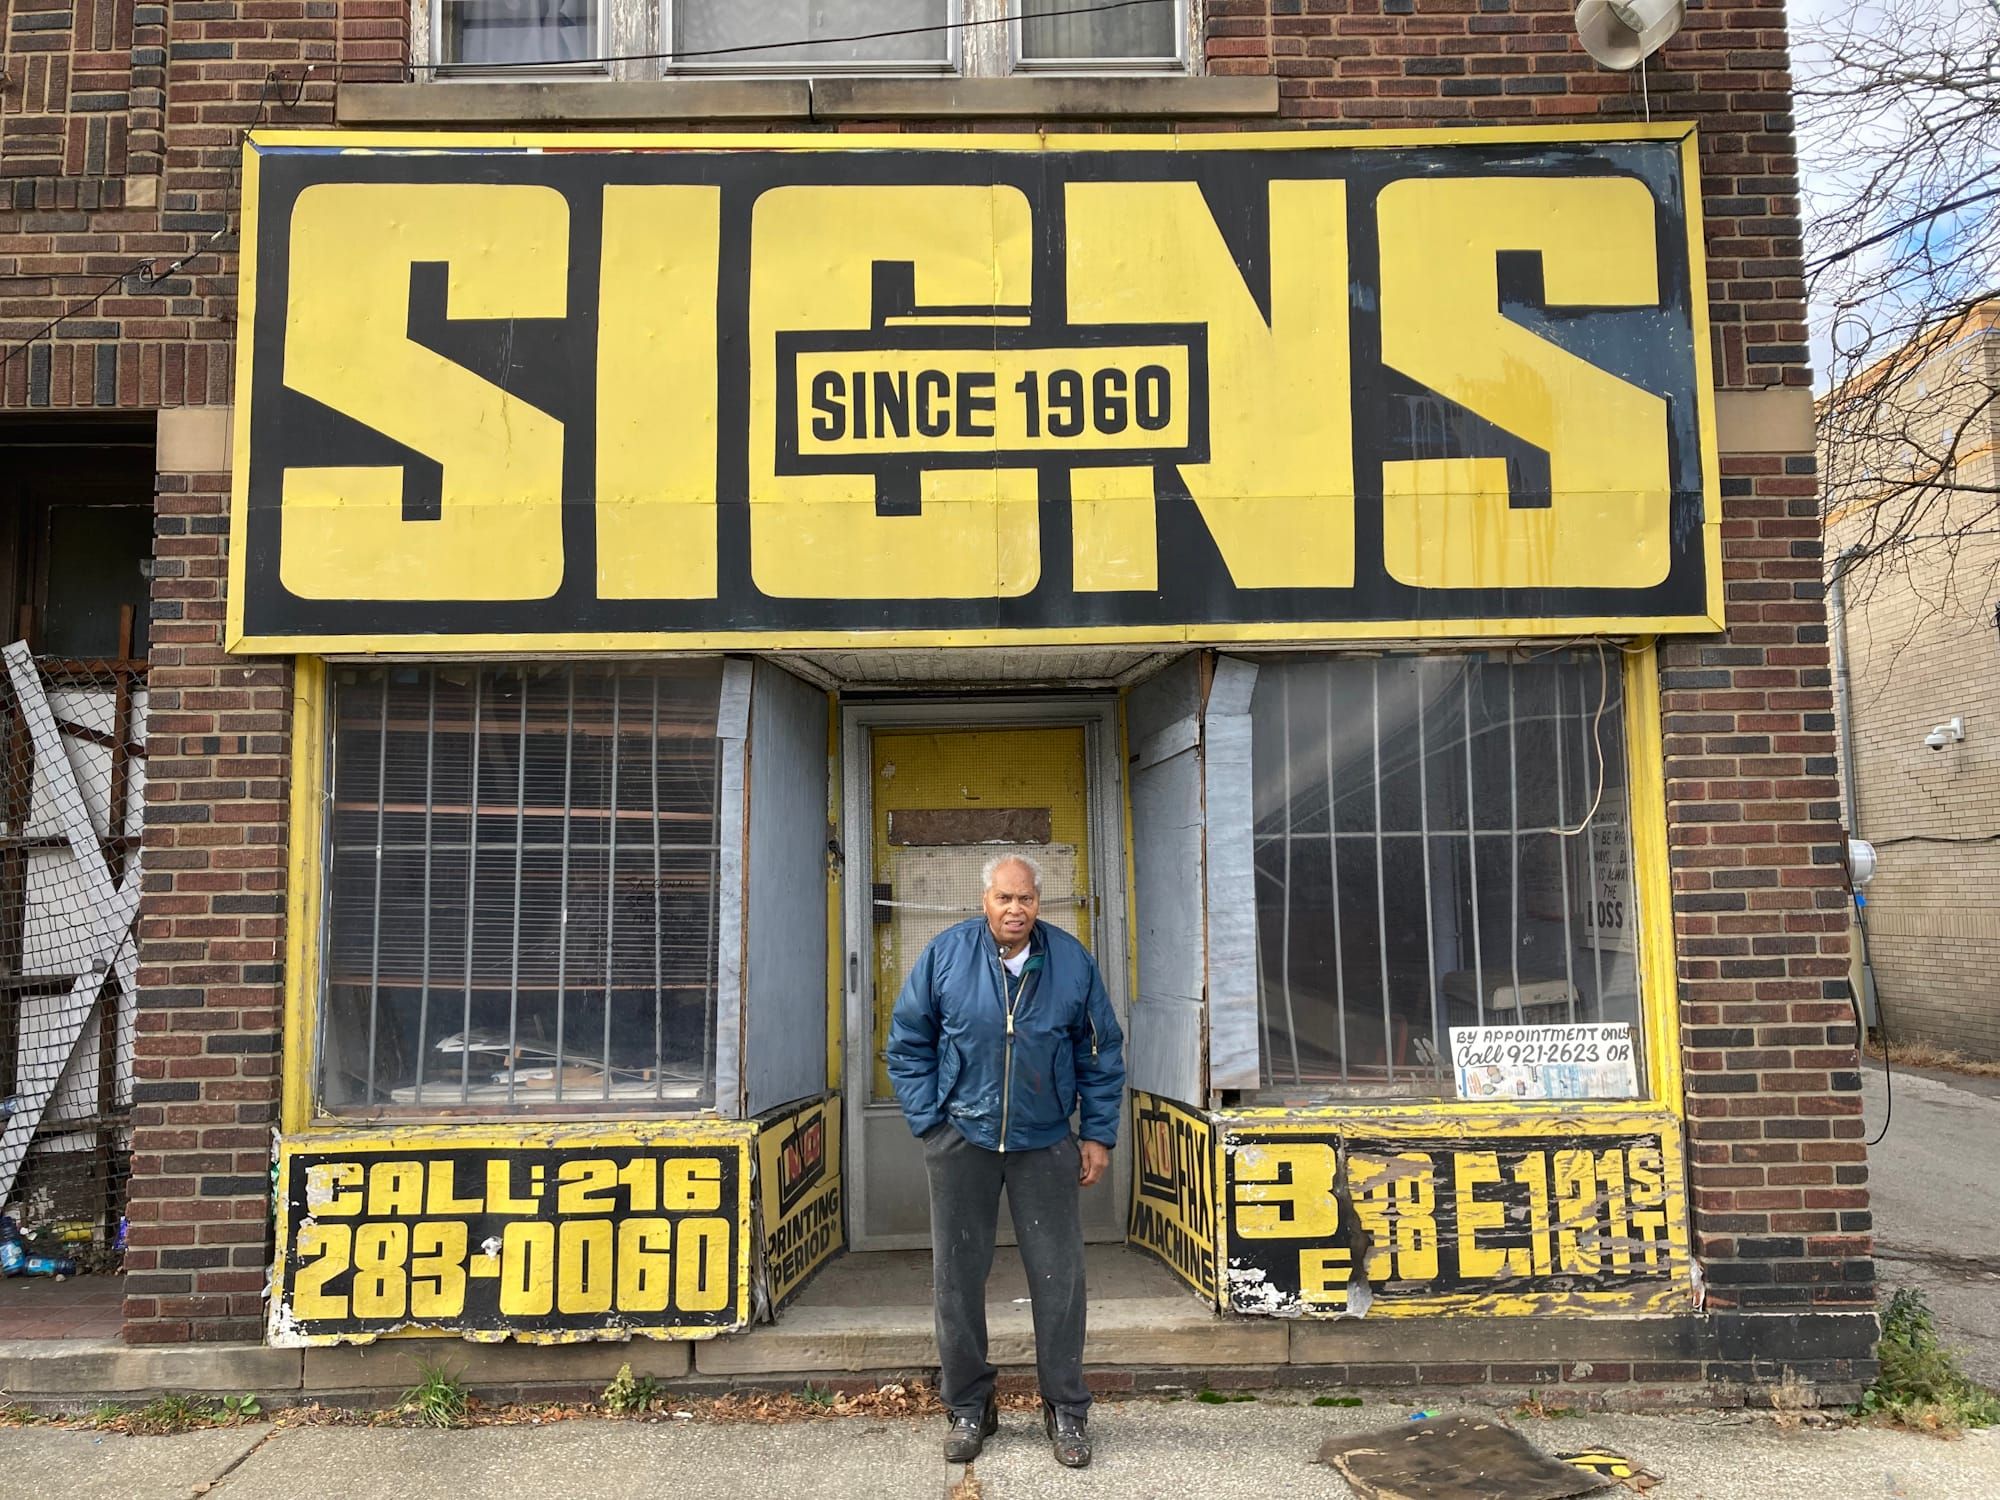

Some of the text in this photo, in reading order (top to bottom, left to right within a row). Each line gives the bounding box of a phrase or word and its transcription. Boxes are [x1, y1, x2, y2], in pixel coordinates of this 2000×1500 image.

[280, 177, 1672, 602] SIGNS
[812, 365, 1171, 441] SINCE 1960
[1603, 883, 1617, 900] THE
[1457, 1026, 1632, 1045] BY APPOINTMENT ONLY
[1457, 1043, 1631, 1067] Call 921-2623 OR
[783, 1121, 821, 1187] NO
[1141, 1116, 1213, 1244] NO FAX
[767, 1186, 839, 1260] PRINTING
[1131, 1200, 1216, 1296] MACHINE
[292, 1216, 730, 1320] 283-0060
